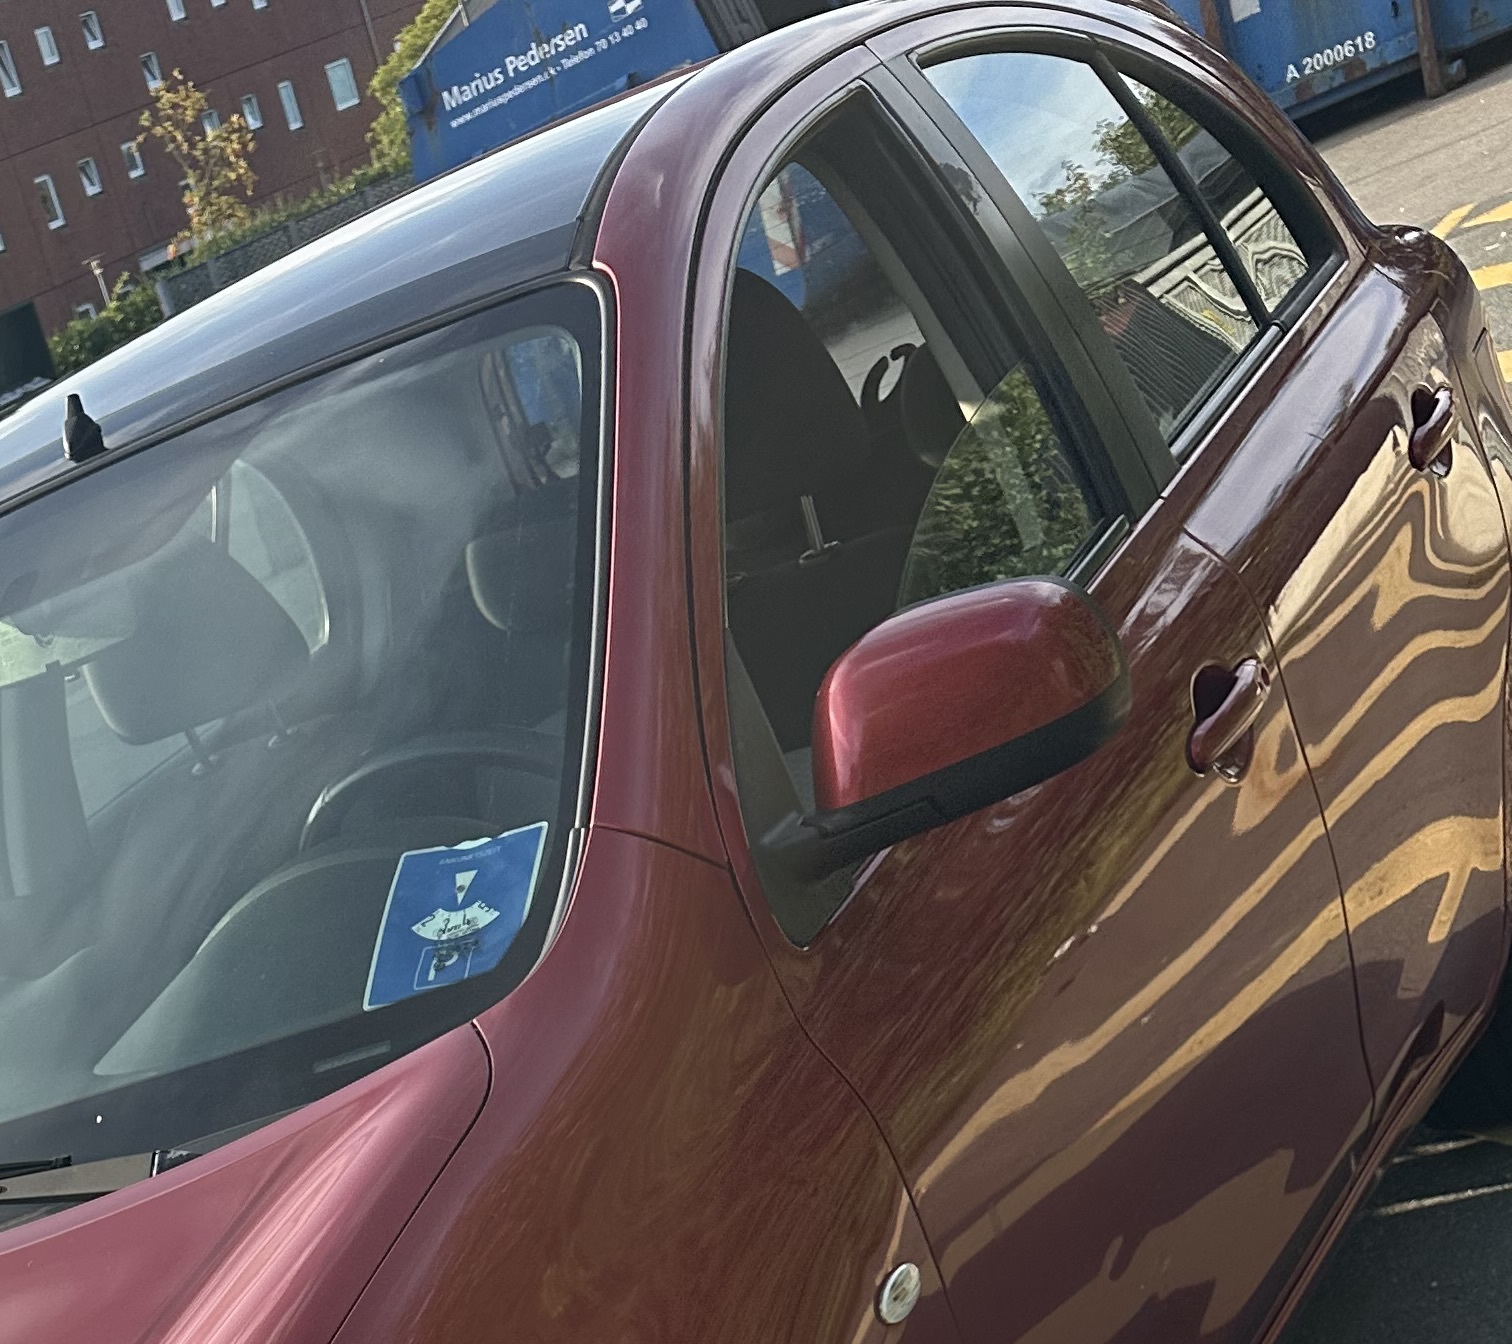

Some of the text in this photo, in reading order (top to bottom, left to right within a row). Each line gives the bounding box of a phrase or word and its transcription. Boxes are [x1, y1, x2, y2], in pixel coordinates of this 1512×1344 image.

[441, 22, 589, 111] Marius Pedersen
[560, 47, 596, 70] Telefon
[593, 38, 609, 52] 70
[1285, 30, 1377, 84] A 2000618
